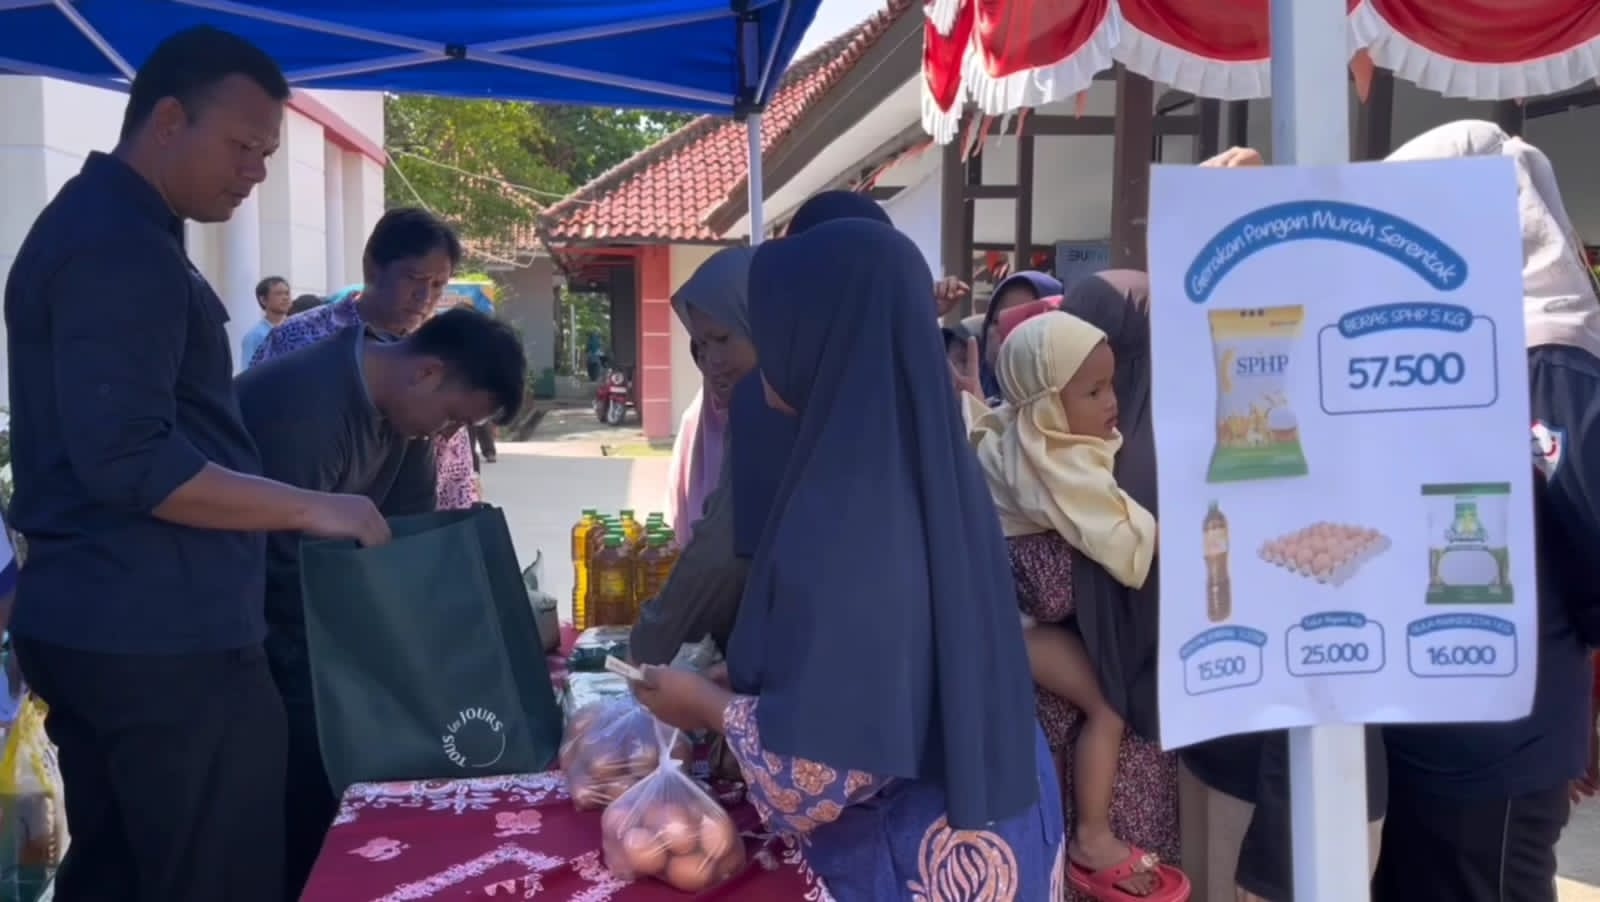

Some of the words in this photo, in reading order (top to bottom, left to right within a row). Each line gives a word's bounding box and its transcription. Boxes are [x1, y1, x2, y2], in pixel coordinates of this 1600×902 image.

[1191, 235, 1246, 295] Gerakan
[1242, 215, 1308, 244] Pangan
[1312, 210, 1375, 238] Murah
[1377, 225, 1457, 284] Serentak
[1236, 354, 1288, 375] SPHP
[1348, 352, 1465, 390] 57.500
[1300, 642, 1369, 665] 25.000
[1425, 645, 1497, 666] 16.000
[442, 734, 467, 768] TOUS
[459, 707, 504, 732] JOURS
